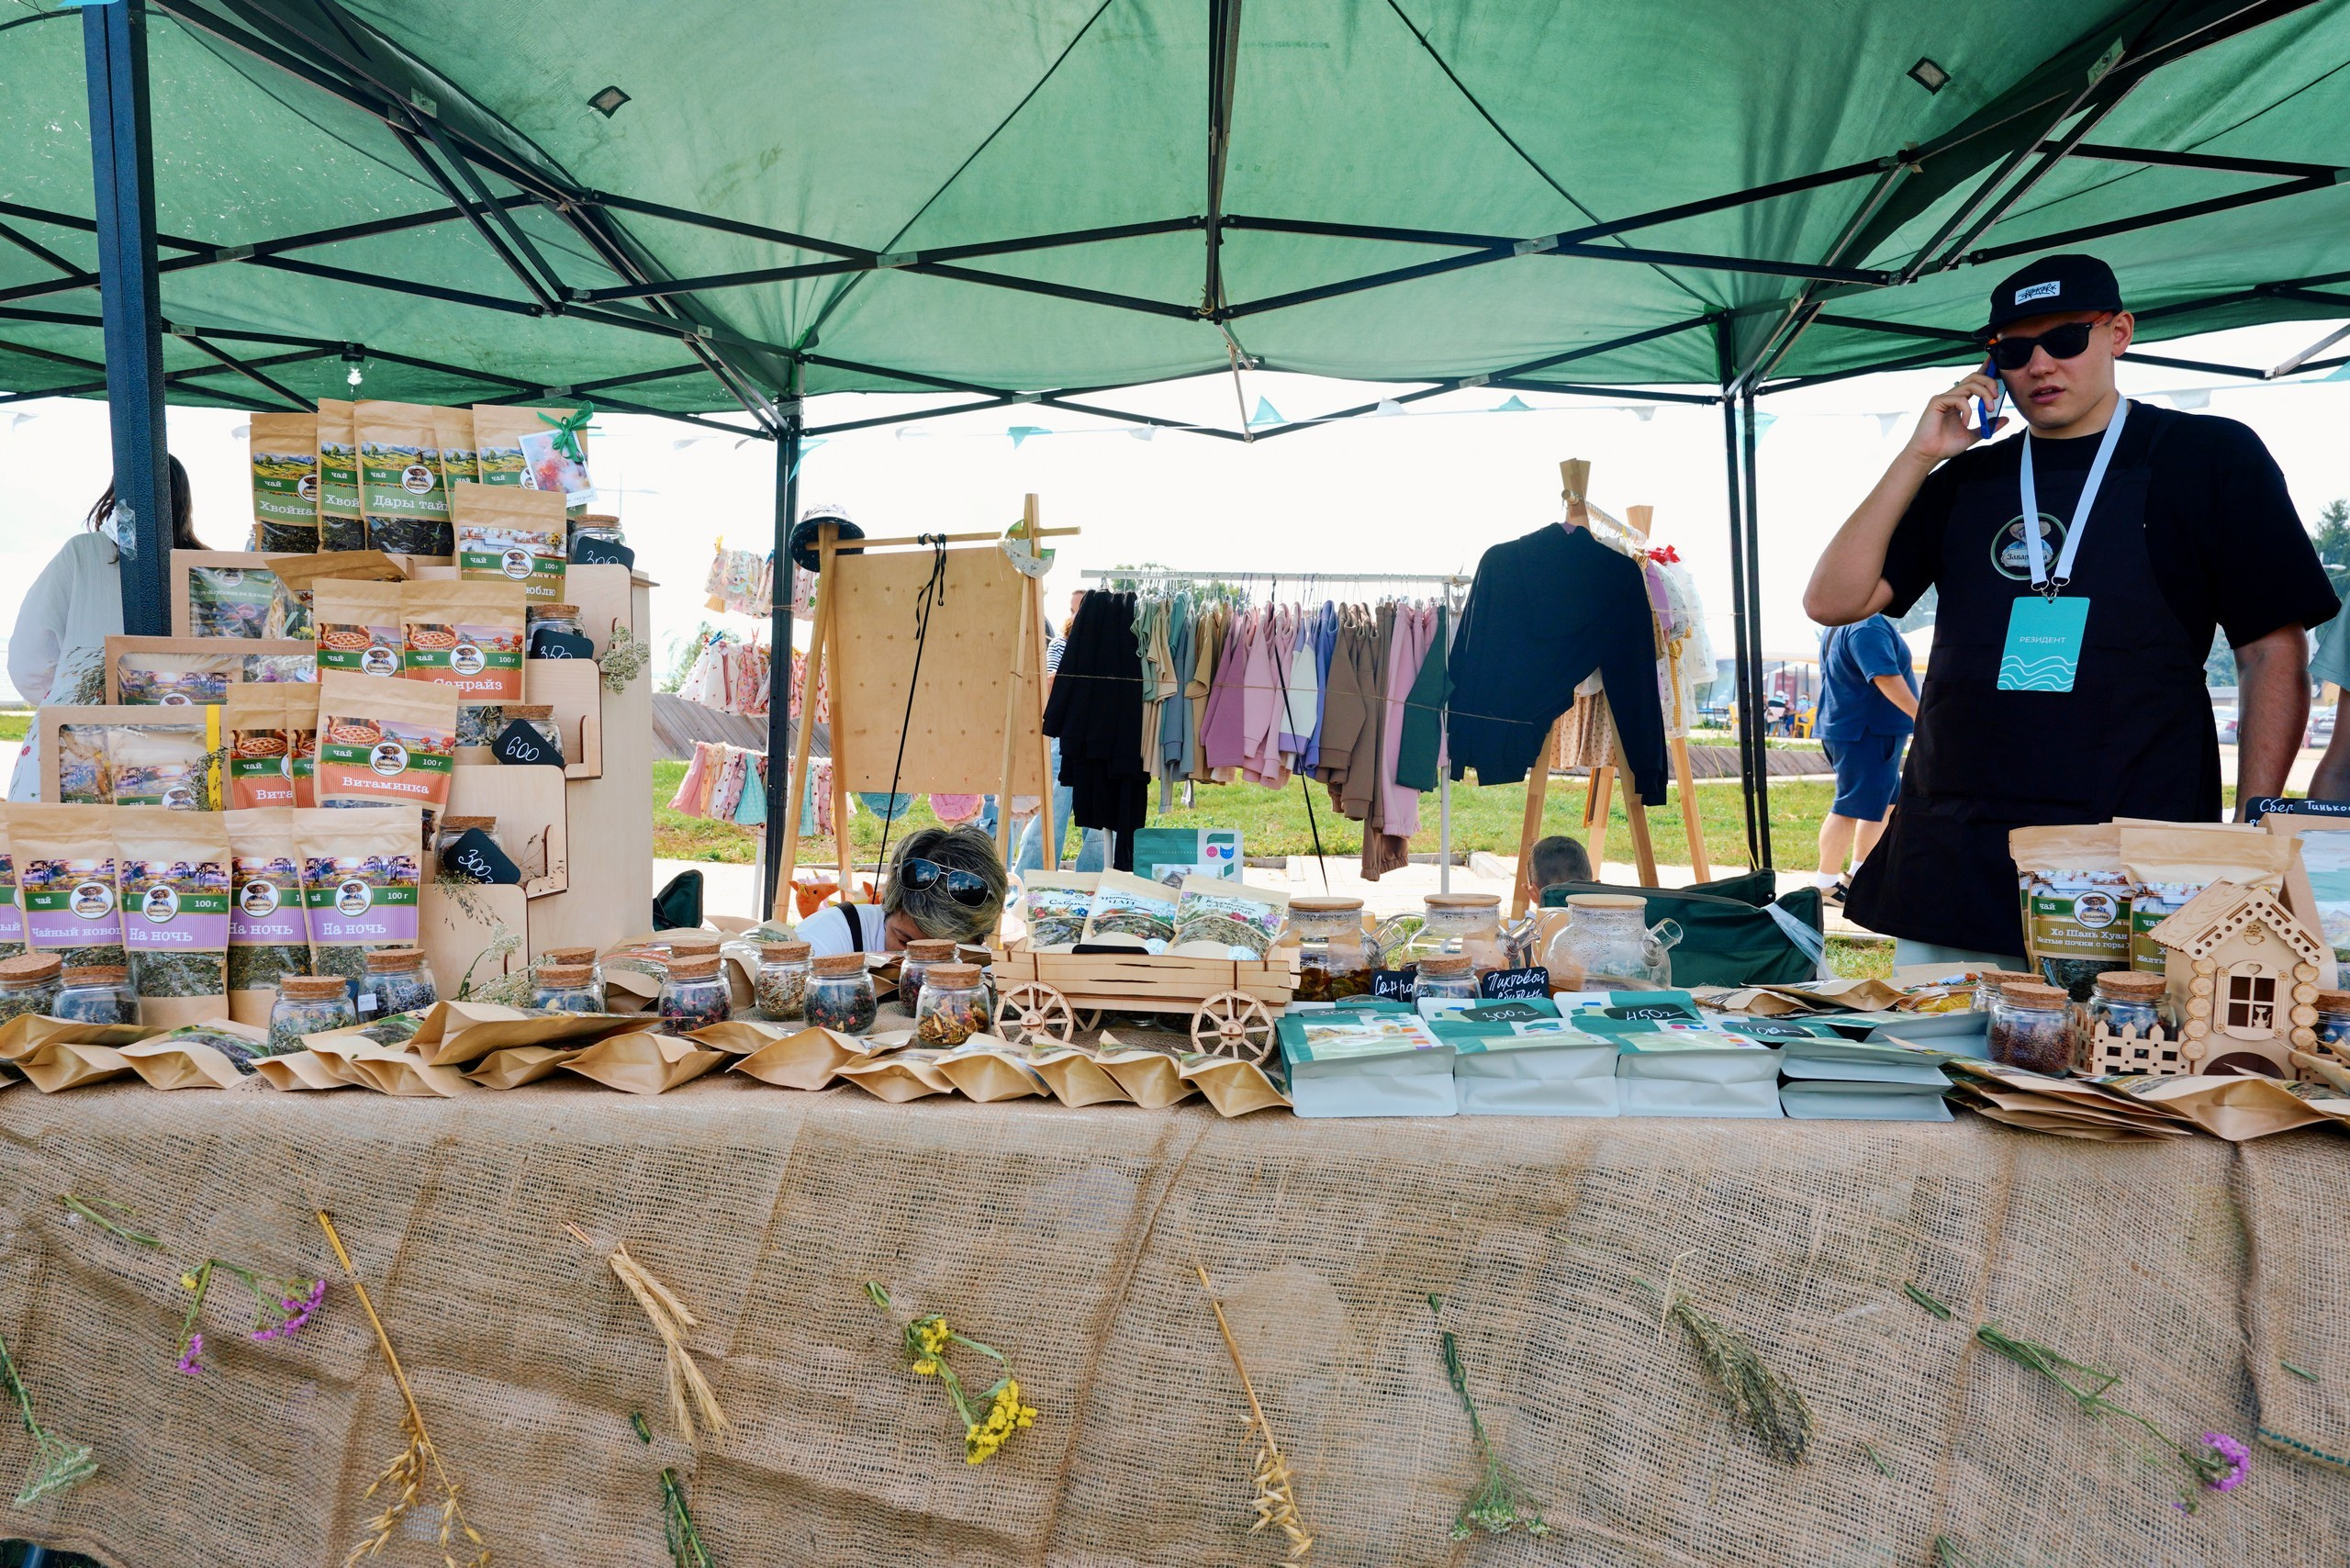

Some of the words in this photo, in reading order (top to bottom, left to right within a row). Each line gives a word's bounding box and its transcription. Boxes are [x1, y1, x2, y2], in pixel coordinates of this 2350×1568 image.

[374, 495, 415, 509] Дары
[2020, 636, 2067, 644] РЕЗИДЕНТ
[434, 678, 503, 691] Снрайз
[333, 748, 352, 757] чай
[506, 736, 540, 762] 600
[242, 761, 263, 770] чай
[422, 758, 438, 767] 100
[342, 777, 430, 795] Витаминка
[2259, 798, 2295, 814] Сбер
[458, 849, 492, 877] 300
[35, 896, 51, 904] чай
[194, 900, 211, 908] 100
[2039, 902, 2056, 911] чай
[32, 925, 79, 937] Чайный
[129, 927, 148, 941] На
[151, 928, 193, 942] ночь
[250, 923, 294, 935] ночь
[322, 923, 342, 935] На
[345, 923, 387, 935] ночь
[2051, 927, 2064, 936] Хо
[2065, 929, 2098, 939] Шань
[2100, 931, 2128, 941] Хуан
[2065, 938, 2094, 947] почки
[1482, 1010, 1515, 1022] 300
